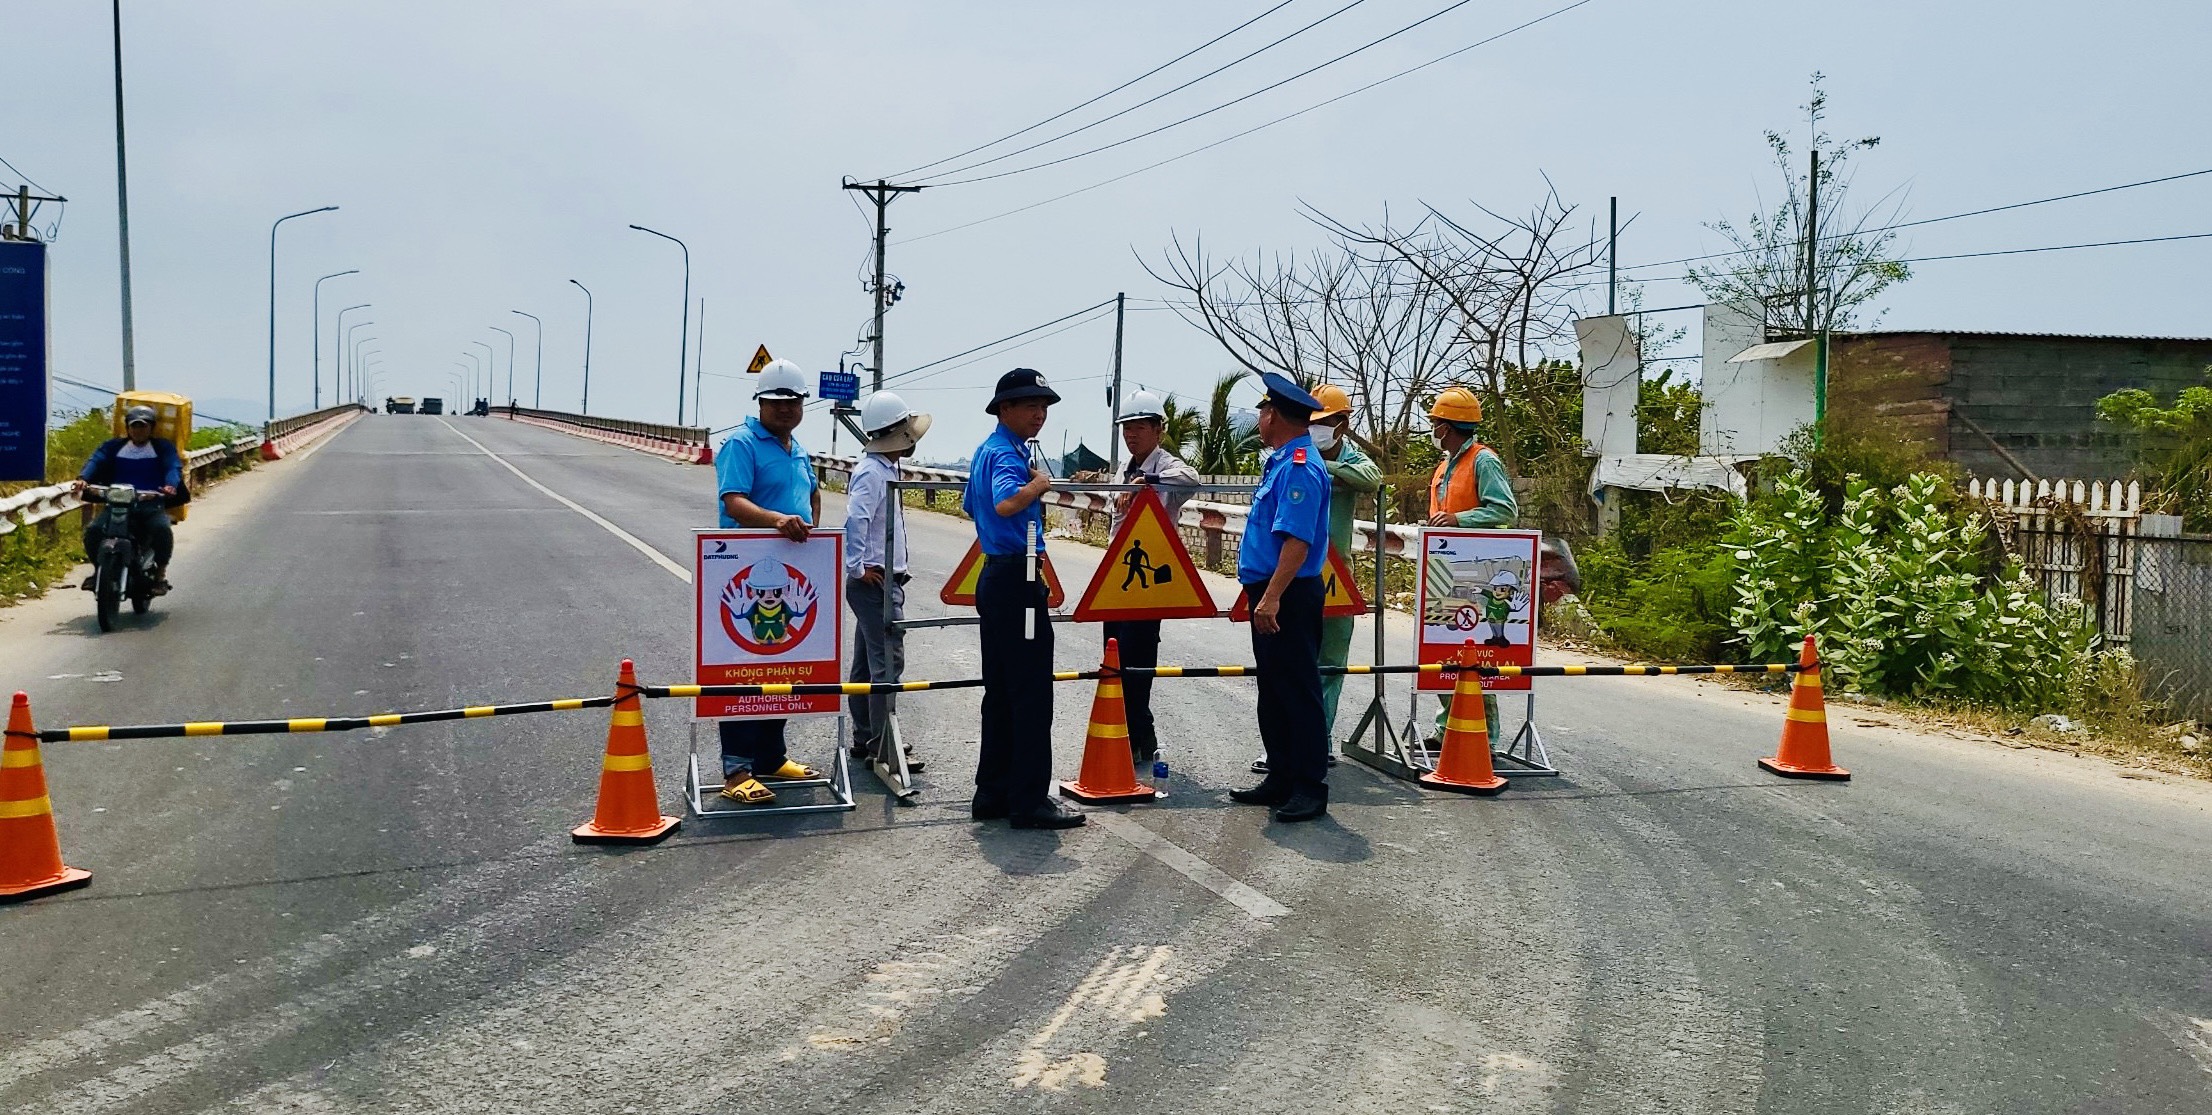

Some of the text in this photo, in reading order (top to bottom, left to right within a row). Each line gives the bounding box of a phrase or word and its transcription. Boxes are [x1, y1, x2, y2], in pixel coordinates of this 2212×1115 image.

[725, 667, 764, 678] KHÔNG
[738, 694, 801, 704] AUTHORISED
[725, 702, 813, 713] PERSONNEL ONLY
